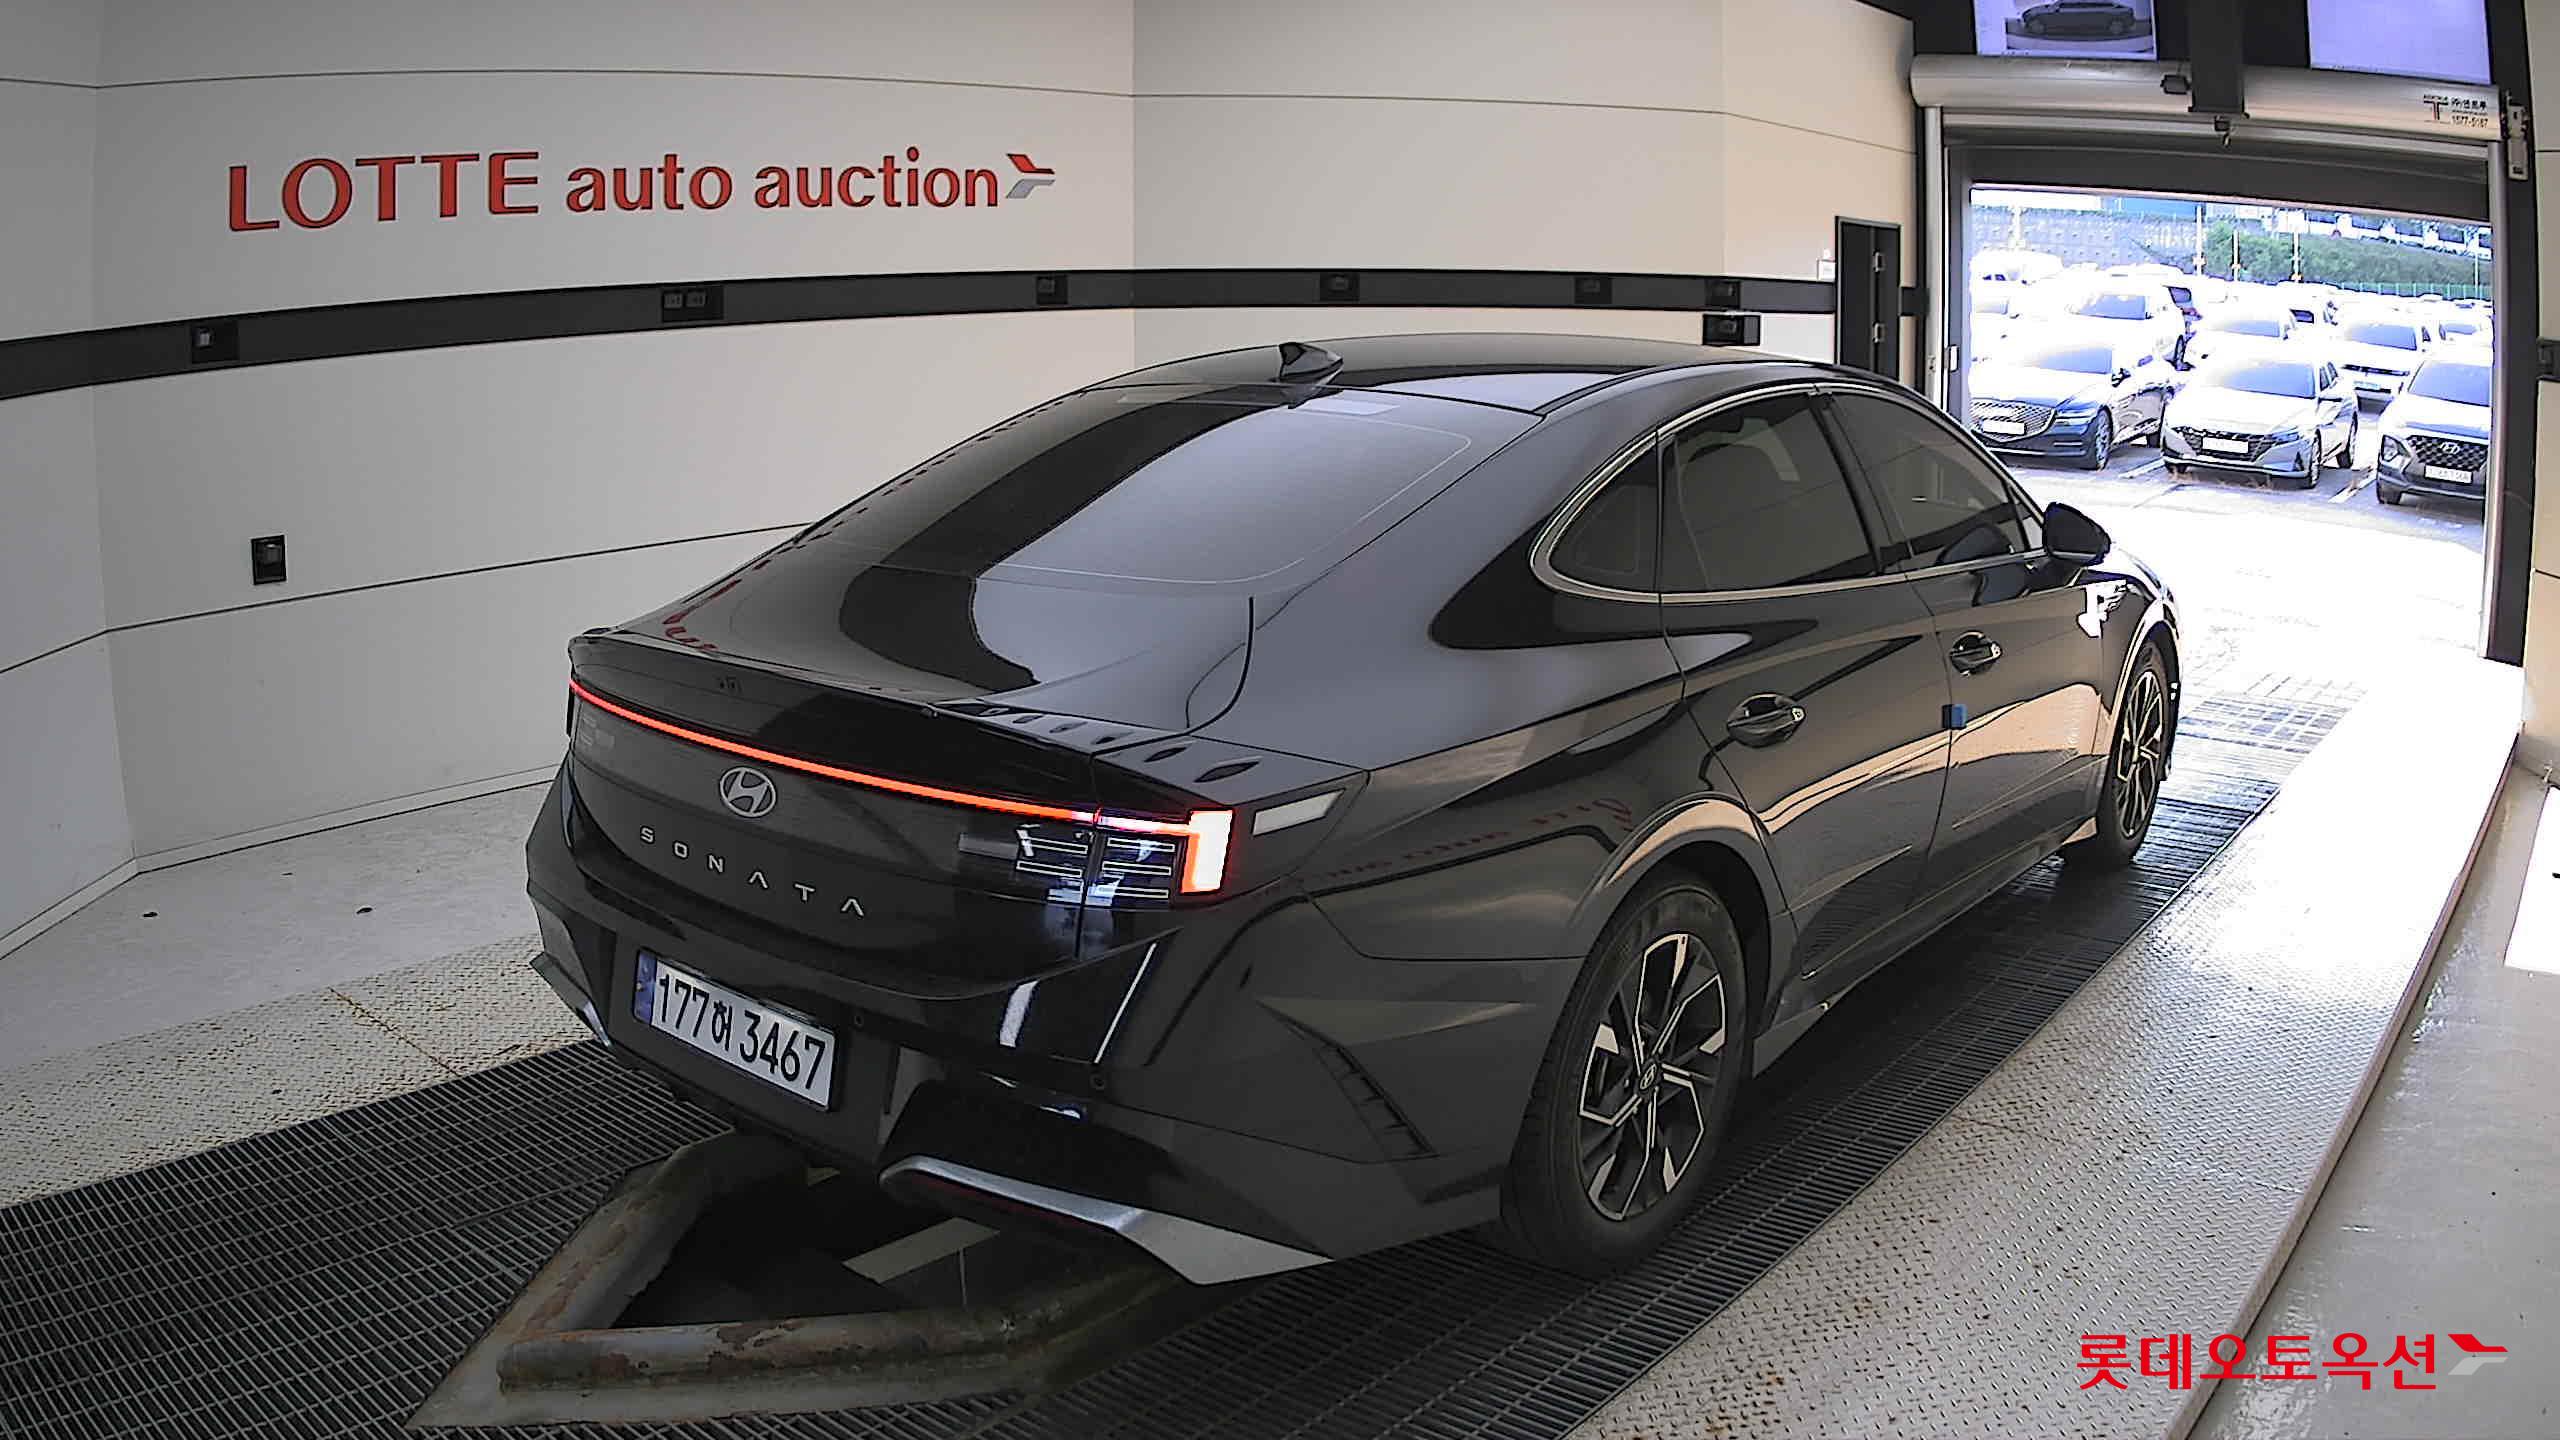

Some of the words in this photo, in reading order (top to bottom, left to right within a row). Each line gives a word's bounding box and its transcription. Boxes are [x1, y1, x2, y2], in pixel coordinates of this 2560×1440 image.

[229, 152, 539, 231] LOTTE
[567, 154, 732, 214] auto
[755, 148, 999, 209] auction
[639, 827, 864, 917] SONATA
